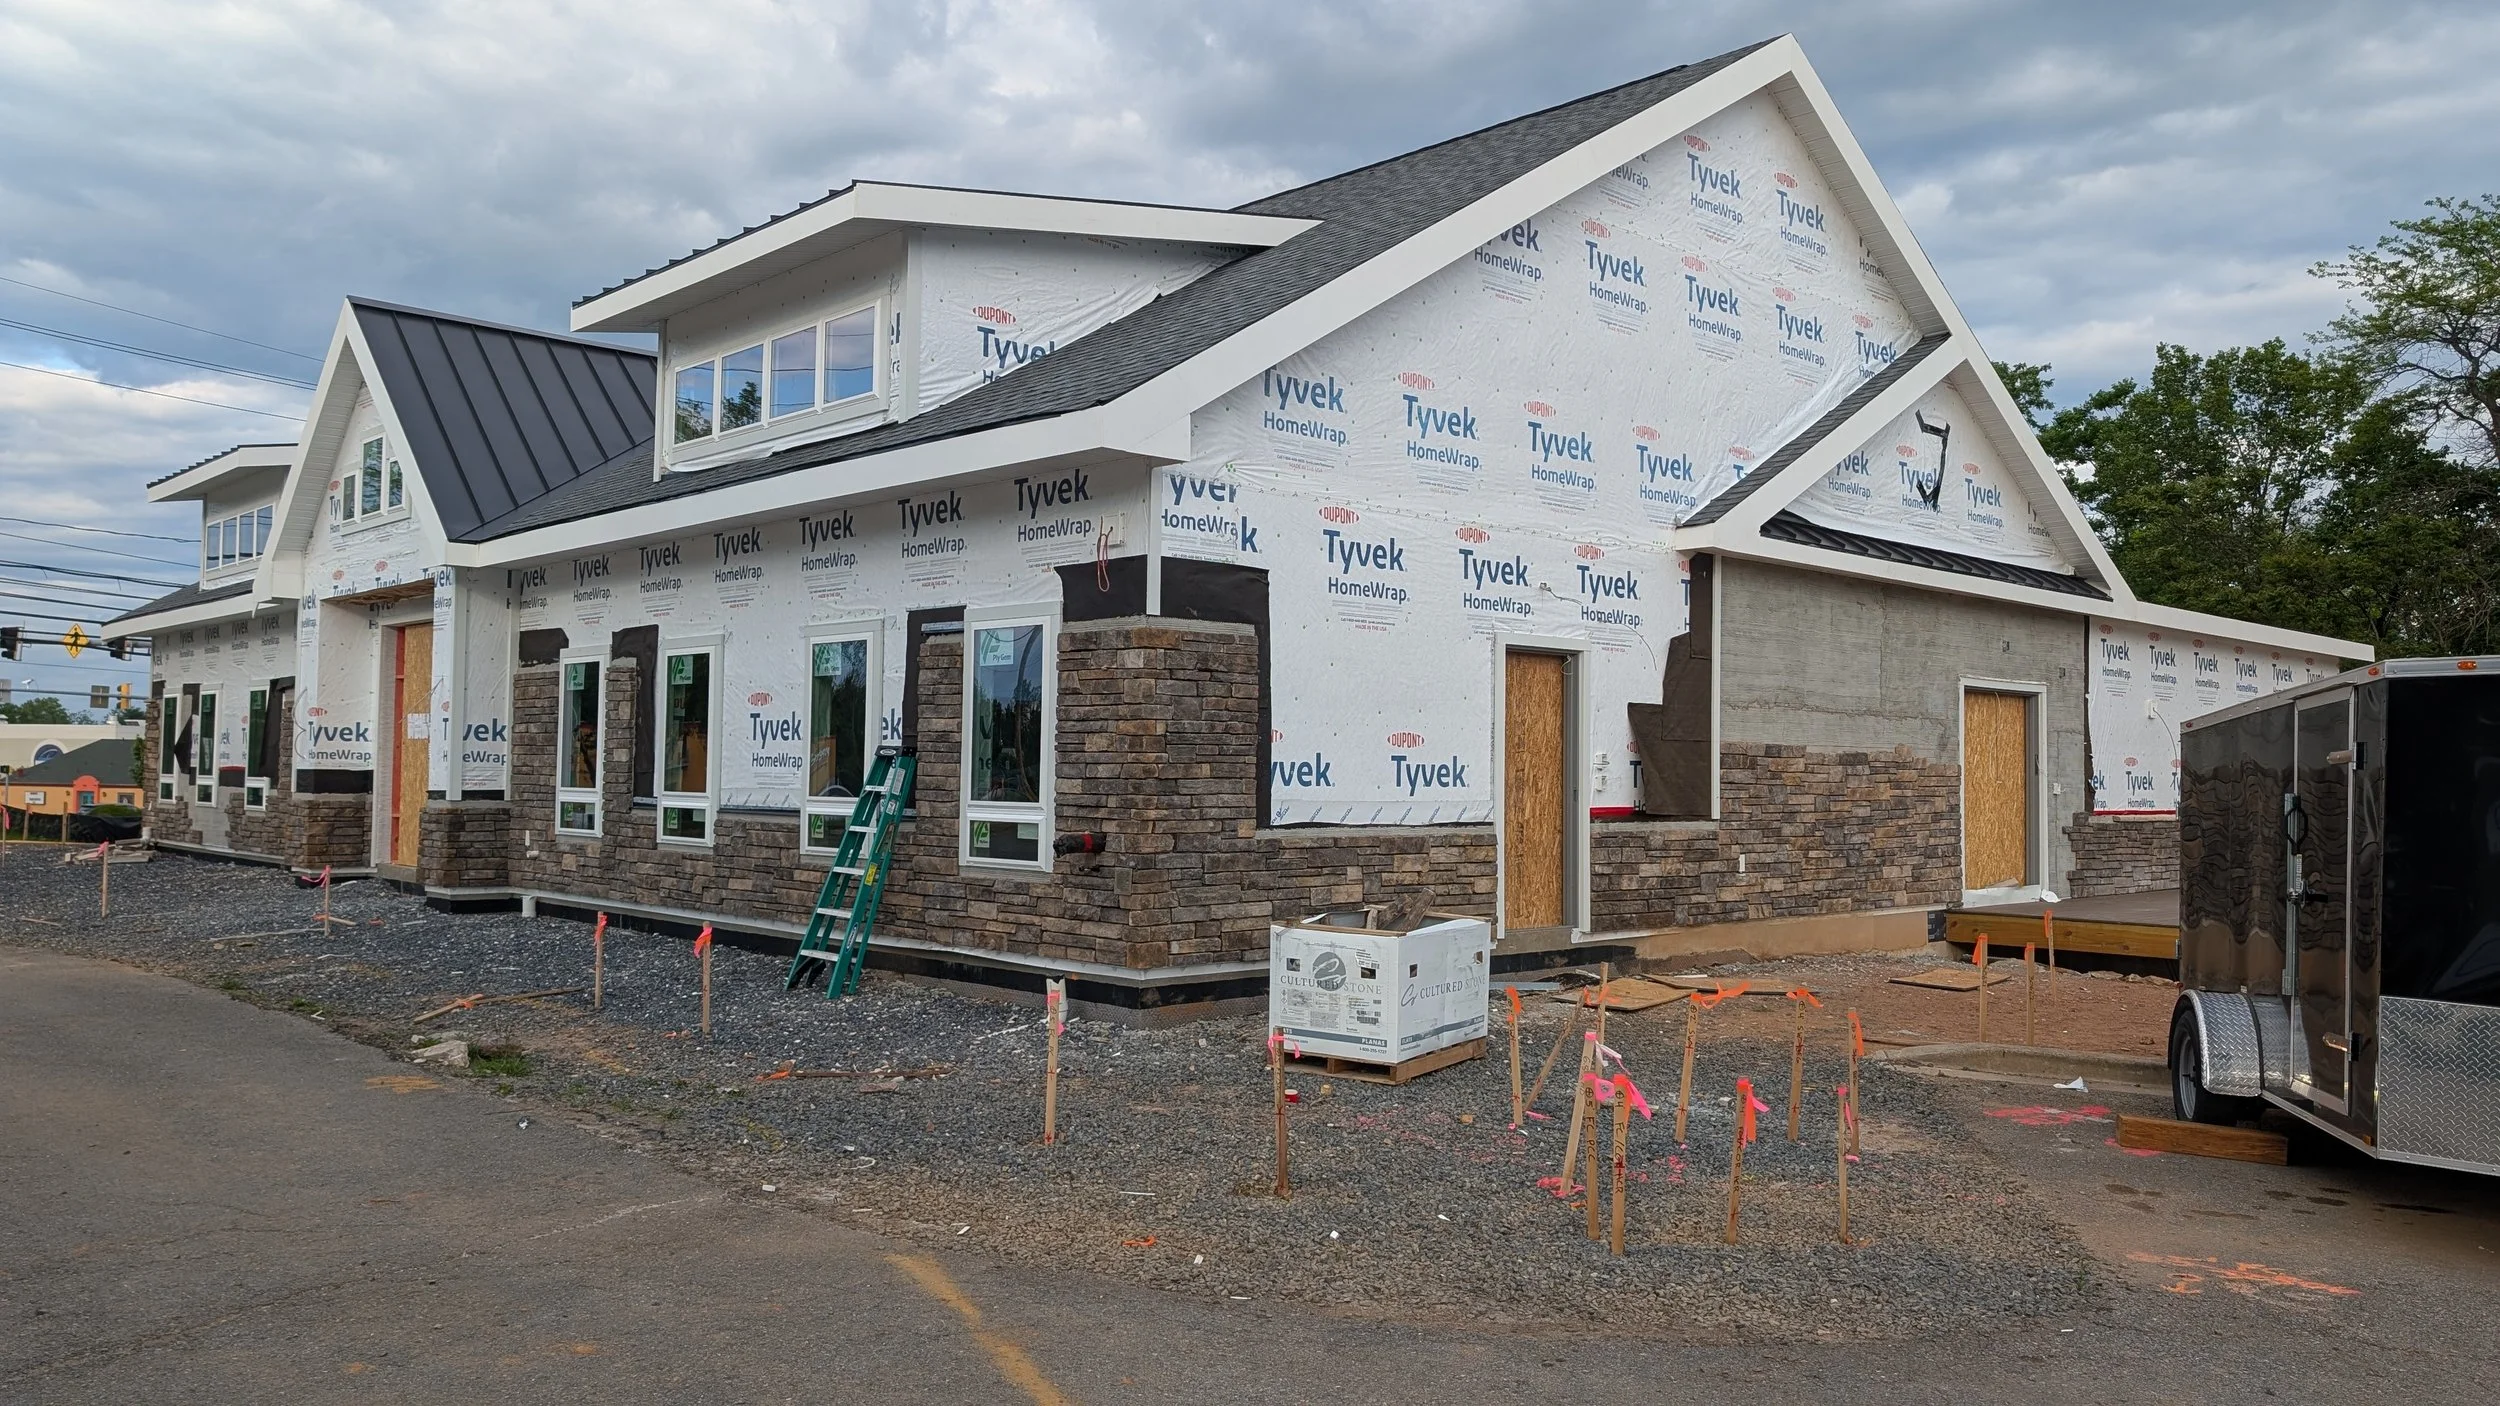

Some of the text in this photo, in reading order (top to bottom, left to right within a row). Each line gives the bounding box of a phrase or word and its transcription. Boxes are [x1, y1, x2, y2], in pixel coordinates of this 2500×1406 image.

[1687, 151, 1741, 198] Tyvek
[1690, 192, 1743, 225] HomeWrap
[1776, 190, 1825, 232] Tyvek
[1487, 219, 1540, 252] vek
[1584, 219, 1609, 239] DUPONT
[1780, 225, 1827, 258] HomeWrap
[1474, 248, 1542, 282] HomeWrap
[1585, 240, 1645, 286] Tyvek
[1589, 281, 1648, 315] HomeWrap
[1685, 274, 1739, 316] Tyvek
[978, 306, 1012, 325] DUPONT
[1689, 313, 1742, 343] HomeWrap
[1776, 304, 1823, 343] Tyvek
[1779, 341, 1825, 368] HomeWrap
[1264, 366, 1344, 413] Tyvek
[1402, 372, 1432, 391] DUPONT
[1402, 394, 1477, 440] Tyvek
[1527, 401, 1553, 417] DUPONT
[1264, 411, 1347, 447] HomeWrap
[1528, 421, 1593, 463] Tyvek
[1636, 425, 1658, 440] DUPONT
[1407, 440, 1480, 471] HomeWrap
[1636, 444, 1693, 483] Tyvek
[1531, 463, 1595, 491] HomeWrap
[1828, 477, 1871, 500] HomeWrap
[1014, 468, 1090, 519] Tyvek
[1639, 484, 1697, 507] HomeWrap
[1965, 478, 2001, 508] Tyvek
[898, 490, 964, 537] Tyvek
[1323, 506, 1356, 525] DUPONT
[1967, 509, 2004, 529] HomeWrap
[799, 510, 854, 551] Tyvek
[1018, 517, 1092, 543] HomeWrap
[1458, 527, 1488, 544] DUPONT
[638, 541, 681, 576] Tyvek
[714, 526, 761, 565] Tyvek
[902, 535, 966, 559] HomeWrap
[1323, 529, 1405, 575] Tyvek
[1578, 545, 1602, 560] DUPONT
[573, 554, 610, 587] Tyvek
[715, 565, 762, 583] HomeWrap
[801, 552, 857, 573] HomeWrap
[1458, 549, 1529, 590] Tyvek
[573, 587, 611, 603] HomeWrap
[640, 577, 682, 594] HomeWrap
[1328, 577, 1407, 605] HomeWrap
[1577, 565, 1638, 603] Tyvek
[1463, 593, 1533, 618] HomeWrap
[1581, 605, 1641, 629] HomeWrap
[2101, 638, 2130, 664] Tyvek
[2149, 645, 2176, 671] Tyvek
[2193, 651, 2219, 676] Tyvek
[2102, 665, 2131, 680] HomeWrap
[2151, 671, 2178, 686] HomeWrap
[2235, 658, 2258, 681] Tyvek
[2272, 663, 2293, 686] Tyvek
[308, 721, 369, 747] Tyvek
[750, 711, 801, 750] Tyvek
[1391, 732, 1422, 748] DUPONT
[309, 750, 372, 763] HomeWrap
[752, 753, 803, 771] HomeWrap
[1391, 754, 1466, 797] Tyvek
[2126, 770, 2154, 796] Tyvek
[2127, 797, 2155, 809] HomeWrap
[1281, 975, 1382, 995] CULTURED STONE
[1420, 980, 1463, 999] CULTURED
[1361, 1038, 1385, 1046] PLANAS
